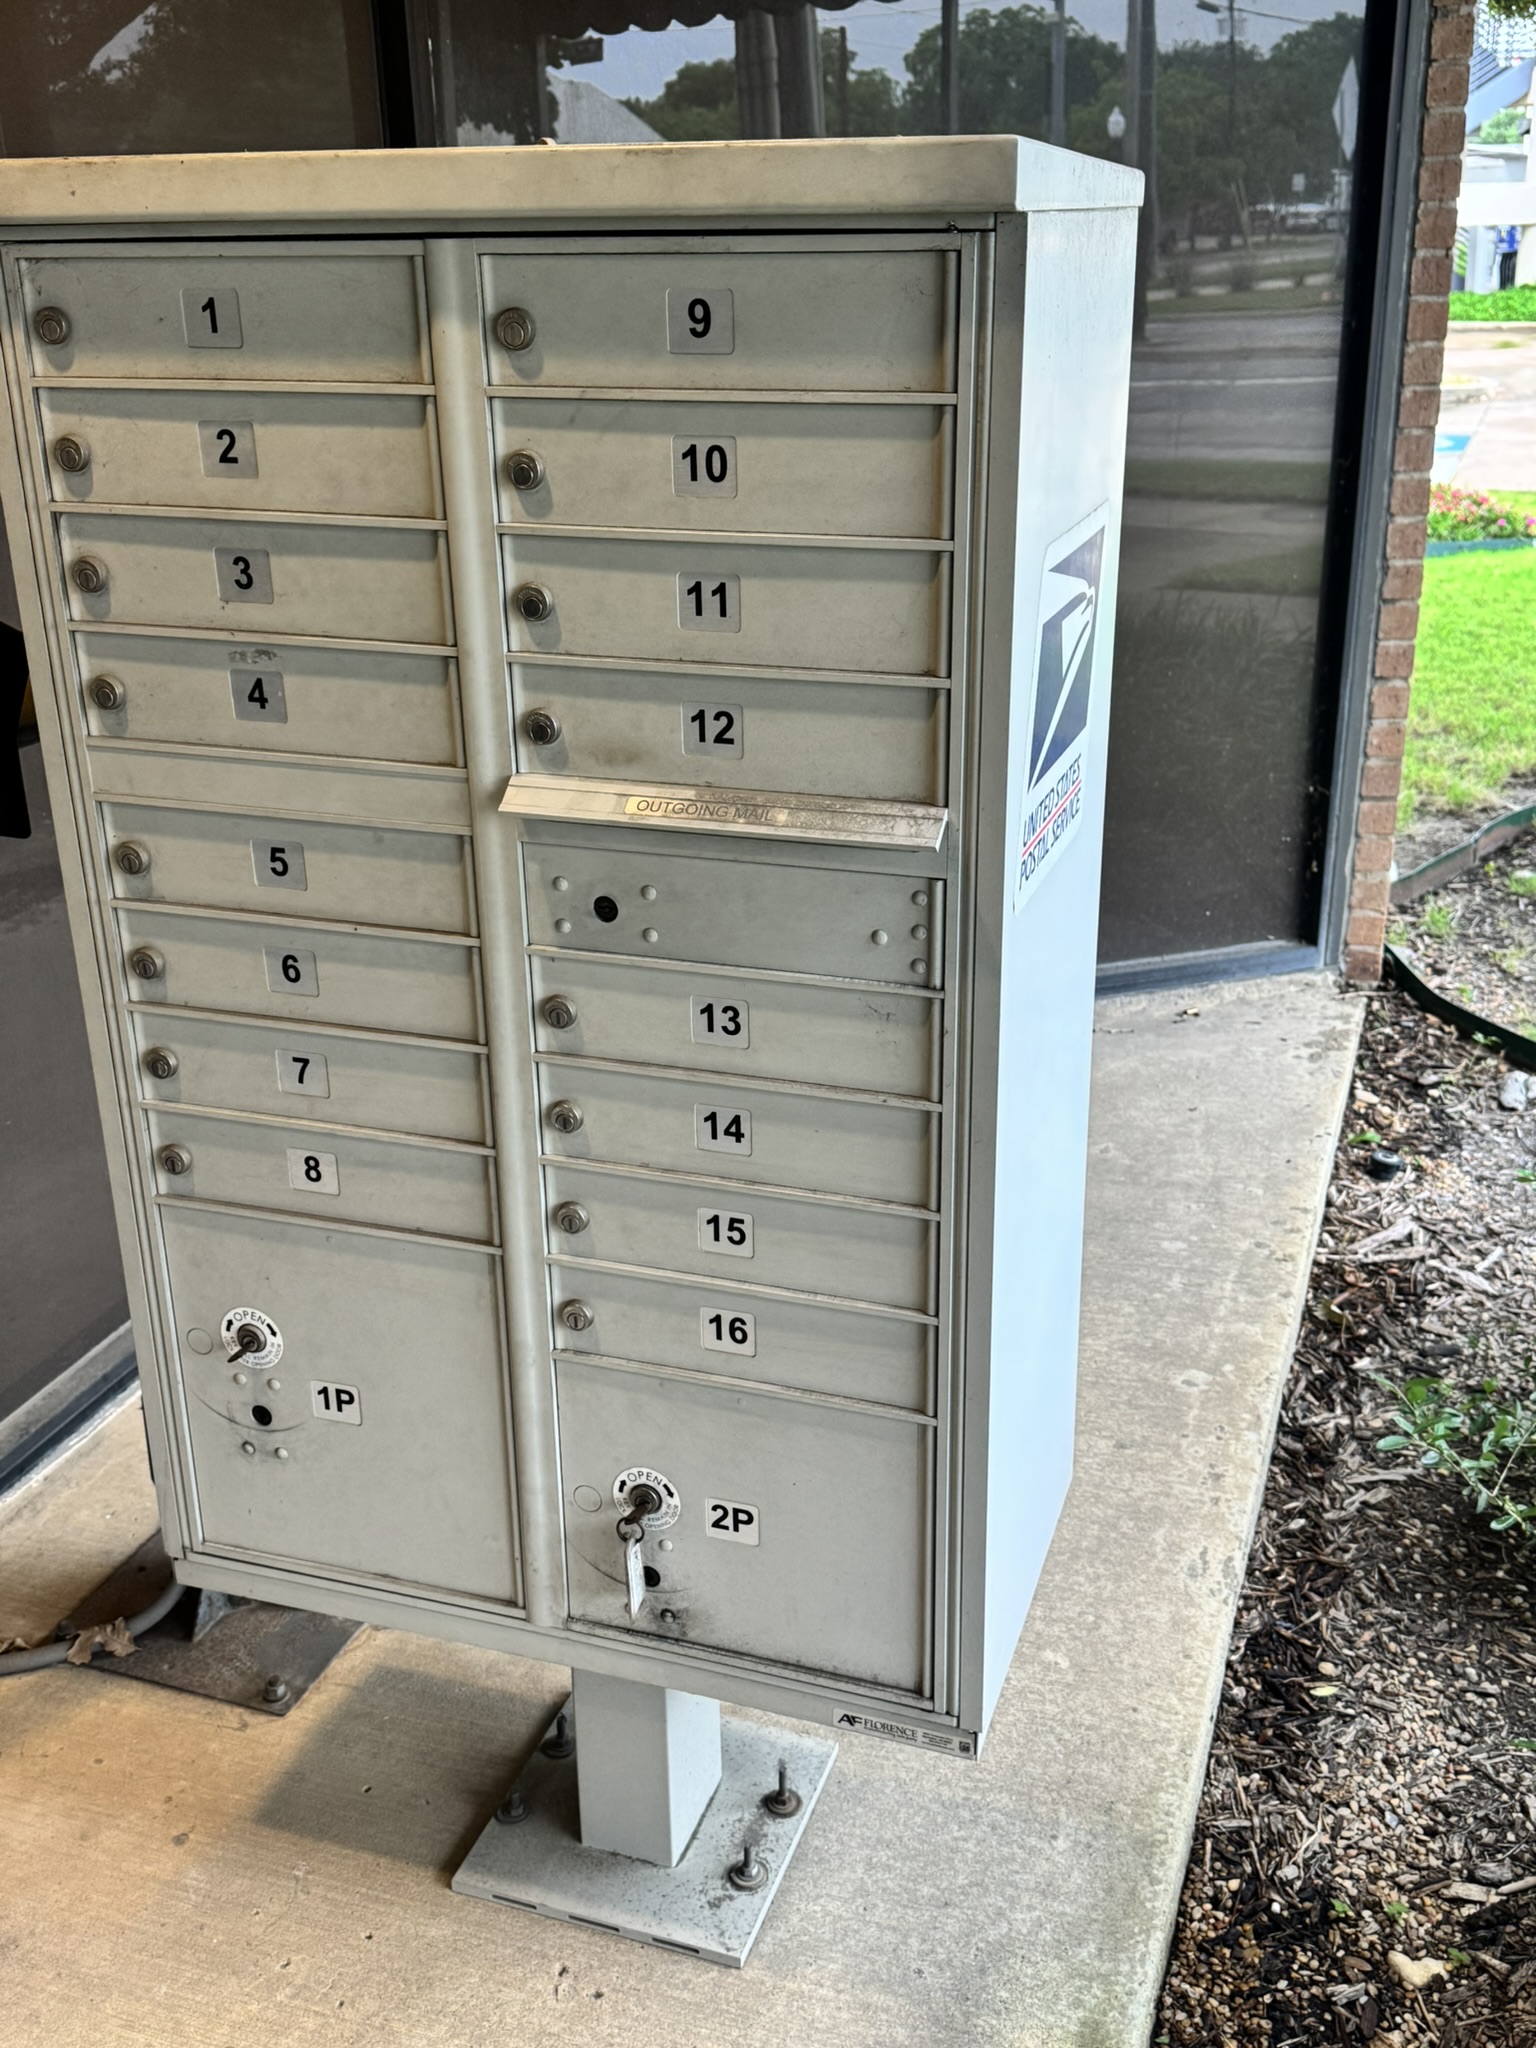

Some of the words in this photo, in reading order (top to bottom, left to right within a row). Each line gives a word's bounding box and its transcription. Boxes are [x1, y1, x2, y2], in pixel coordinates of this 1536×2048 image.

[200, 296, 219, 335] 1
[687, 297, 712, 339] 9
[216, 428, 239, 465] 2
[681, 443, 728, 484] 10
[231, 555, 254, 591] 3
[686, 580, 727, 618] 11
[247, 676, 269, 710] 4
[690, 708, 735, 746] 12
[636, 799, 729, 818] OUTGOING
[733, 806, 774, 822] MAIL
[1023, 787, 1055, 848] UNITED
[1055, 753, 1082, 809] STATES
[1018, 829, 1050, 891] POSTAL
[1050, 787, 1081, 848] SERVICE
[269, 846, 289, 877] 5
[281, 954, 301, 984] 6
[699, 1002, 742, 1036] 13
[291, 1056, 310, 1085] 7
[703, 1111, 745, 1144] 14
[304, 1155, 322, 1183] 8
[706, 1214, 747, 1246] 15
[233, 1310, 266, 1325] OPEN
[708, 1313, 748, 1345] 16
[317, 1386, 355, 1413] 1P
[627, 1470, 663, 1486] OPEN
[711, 1504, 754, 1533] 2P
[863, 1717, 918, 1739] FLORENCE
